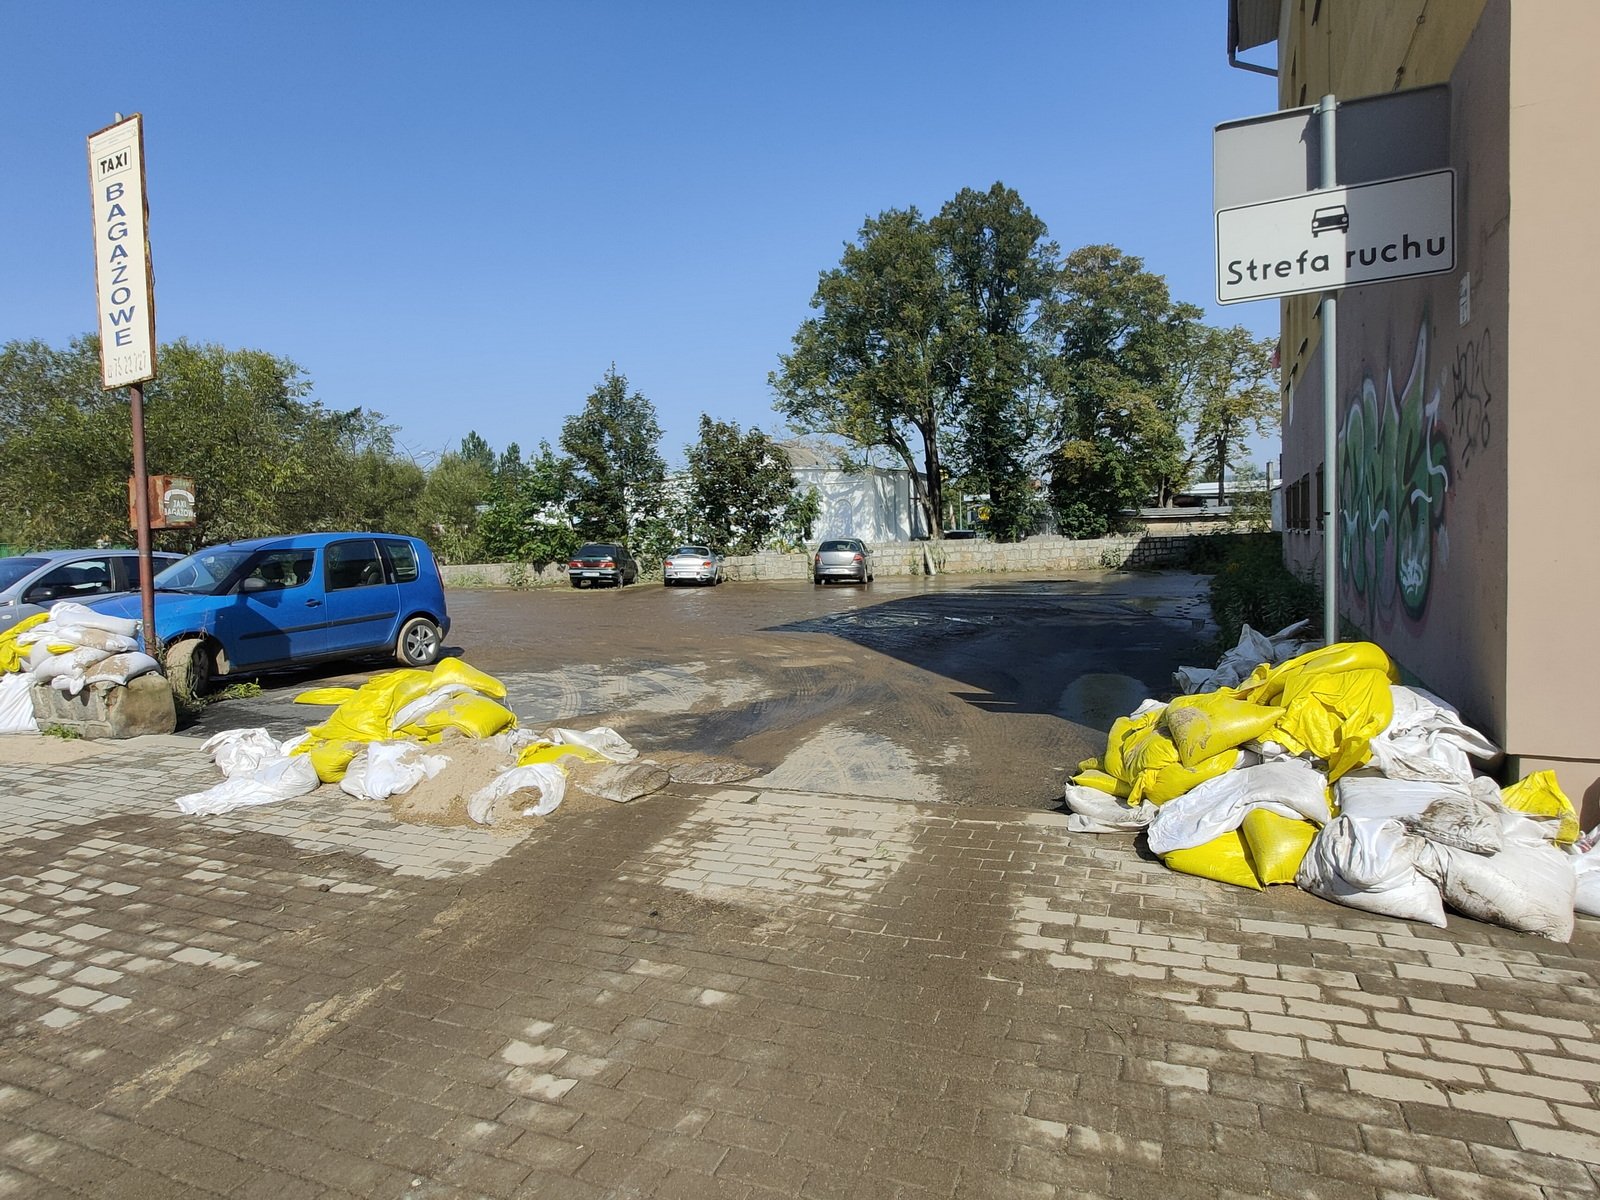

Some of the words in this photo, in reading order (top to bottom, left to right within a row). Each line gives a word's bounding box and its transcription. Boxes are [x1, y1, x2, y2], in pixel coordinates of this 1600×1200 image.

[100, 151, 127, 174] TAXI
[105, 182, 136, 347] BAGAŻOWE
[1226, 249, 1330, 285] Strefa
[1345, 234, 1446, 269] ruchu
[173, 500, 187, 508] TAXI
